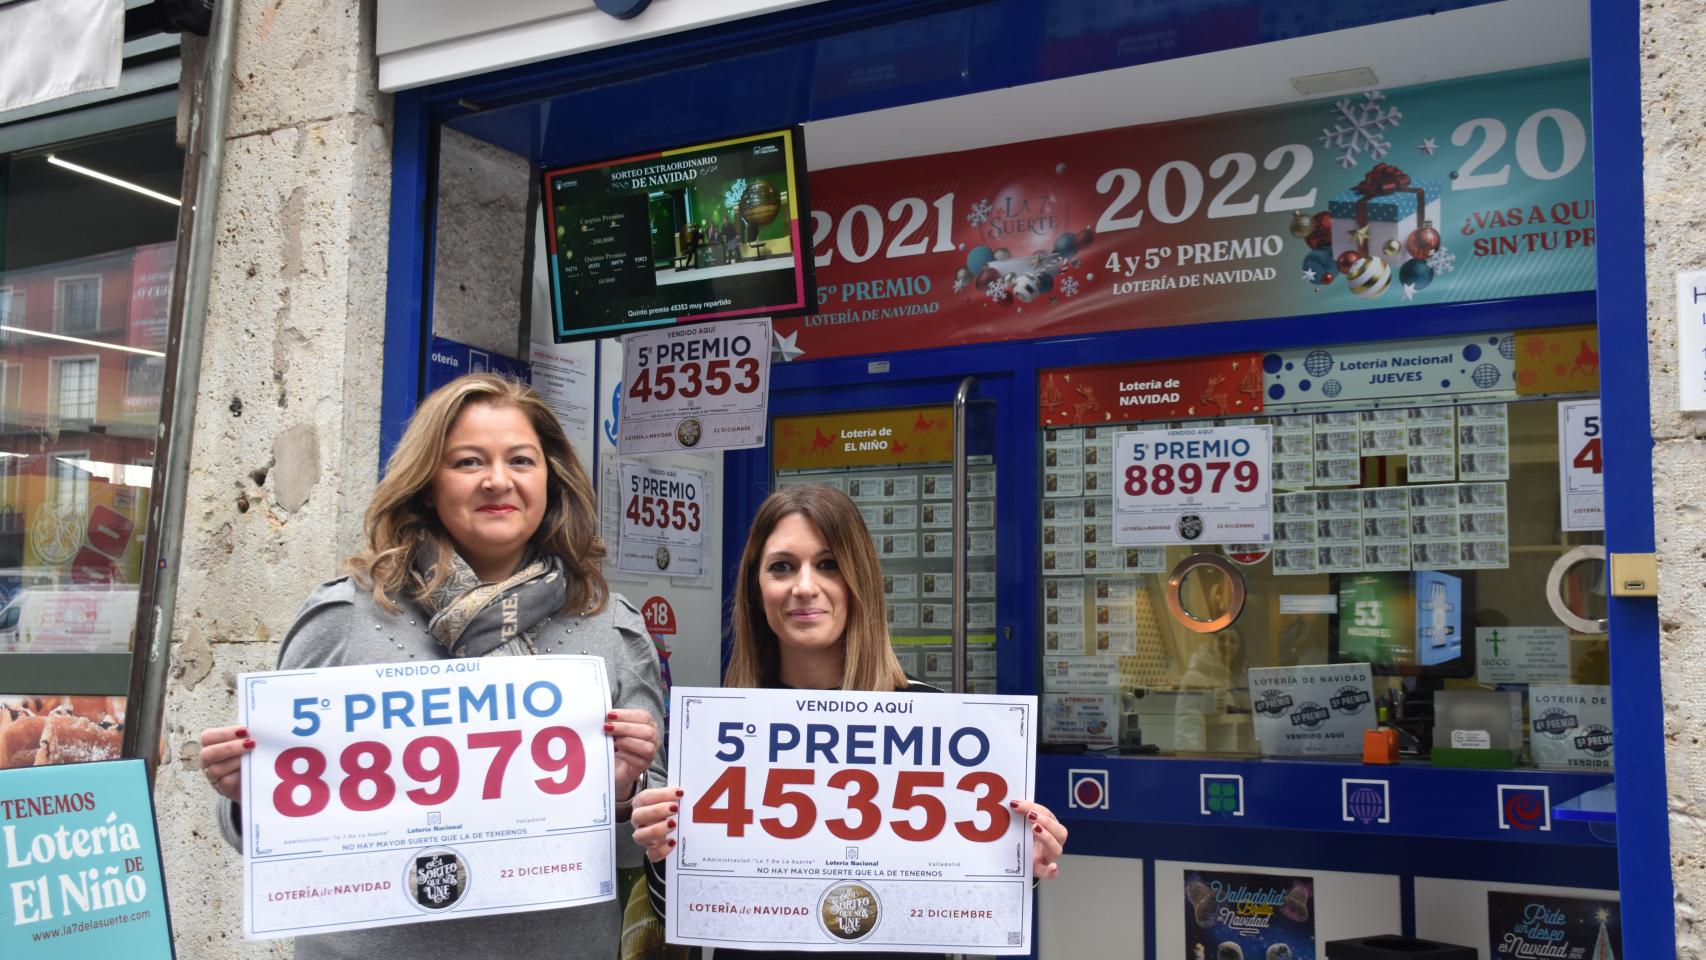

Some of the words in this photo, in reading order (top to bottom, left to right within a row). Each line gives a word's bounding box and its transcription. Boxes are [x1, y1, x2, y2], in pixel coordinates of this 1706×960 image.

[1451, 108, 1586, 191] 20
[611, 168, 643, 181] SORTEO
[644, 155, 718, 176] EXTRAORDINARIO
[632, 176, 648, 189] DE
[649, 168, 698, 187] NAVIDAD
[1095, 144, 1318, 234] 2022
[1461, 206, 1523, 237] ¿VAS
[1527, 205, 1546, 225] A
[1550, 200, 1595, 226] QU
[811, 192, 957, 268] 2021
[1473, 234, 1518, 257] SIN
[1522, 231, 1559, 252] TU
[1104, 252, 1122, 274] 4
[1124, 255, 1141, 277] y
[1144, 246, 1172, 270] 5º
[1177, 234, 1284, 267] PREMIO
[841, 275, 932, 303] PREMIO
[1112, 274, 1177, 296] LOTERÍA
[1179, 271, 1201, 288] DE
[1202, 266, 1277, 286] NAVIDAD
[627, 307, 648, 318] Quinto
[648, 305, 670, 317] premio
[670, 303, 689, 313] 45353
[688, 302, 703, 313] muy
[702, 297, 732, 310] repartido
[804, 309, 861, 328] LOTERÍA
[862, 309, 880, 322] DE
[880, 301, 941, 320] NAVIDAD
[667, 328, 697, 339] VENDIDO
[698, 324, 716, 335] AQUÍ
[638, 346, 653, 368] 5º
[657, 335, 751, 365] PREMIO
[1391, 353, 1454, 368] Nacional
[628, 357, 761, 403] 45353
[1164, 378, 1180, 389] de
[1369, 371, 1423, 384] JUEVES
[1119, 392, 1181, 406] NAVIDAD
[879, 427, 893, 437] de
[1168, 429, 1196, 437] VENDIDO
[845, 442, 857, 452] EL
[859, 439, 888, 451] NIÑO
[1155, 438, 1251, 461] PREMIO
[643, 476, 696, 501] PREMIO
[1124, 460, 1260, 497] 88979
[626, 494, 701, 533] 45353
[645, 602, 669, 626] +18
[1354, 600, 1384, 627] 53
[375, 664, 441, 678] VENDIDO
[445, 661, 480, 674] AQUÍ
[1481, 657, 1511, 667] aecc
[1302, 675, 1316, 684] DE
[1319, 673, 1367, 683] NAVIDAD
[291, 696, 332, 737] 5º
[344, 680, 563, 732] PREMIO
[796, 699, 868, 714] VENDIDO
[873, 700, 913, 715] AQUÍ
[1265, 695, 1292, 709] PREMIO
[1340, 692, 1368, 706] PREMIO
[1535, 695, 1586, 705] LOTERÍA
[1591, 696, 1608, 705] DE
[1302, 708, 1328, 722] PREMIO
[1545, 716, 1577, 729] PREMIO
[715, 722, 757, 763] 5º
[768, 723, 991, 767] PREMIO
[1325, 731, 1345, 739] AQUÍ
[272, 725, 587, 818] 88979
[1, 791, 97, 820] TENEMOS
[692, 766, 1012, 843] 45353
[434, 823, 463, 832] Nacional
[516, 816, 546, 824] Valladolid
[3, 811, 142, 869] Lotería
[342, 842, 355, 850] NO
[357, 841, 374, 849] HAY
[376, 839, 406, 848] MAYOR
[408, 836, 439, 845] SUERTE
[485, 828, 528, 838] TENERNOS
[124, 856, 146, 874] DE
[500, 869, 514, 878] 22
[519, 862, 583, 875] DICIEMBRE
[757, 866, 770, 874] NO
[791, 867, 821, 875] MAYOR
[822, 868, 853, 876] SUERTE
[886, 869, 898, 877] DE
[851, 860, 879, 868] Nacional
[10, 875, 55, 926] El
[58, 866, 147, 916] Niño
[334, 880, 392, 895] NAVIDAD
[1210, 881, 1287, 906] Valladolid
[740, 905, 752, 915] de
[753, 906, 810, 916] NAVIDAD
[910, 909, 924, 918] 22
[928, 909, 994, 920] DICIEMBRE
[1220, 907, 1270, 930] Navidad
[1523, 903, 1566, 925] Pide
[32, 910, 152, 942] www.la7delasuerte.com
[1528, 924, 1565, 941] deseo
[1504, 932, 1569, 960] Navidad
